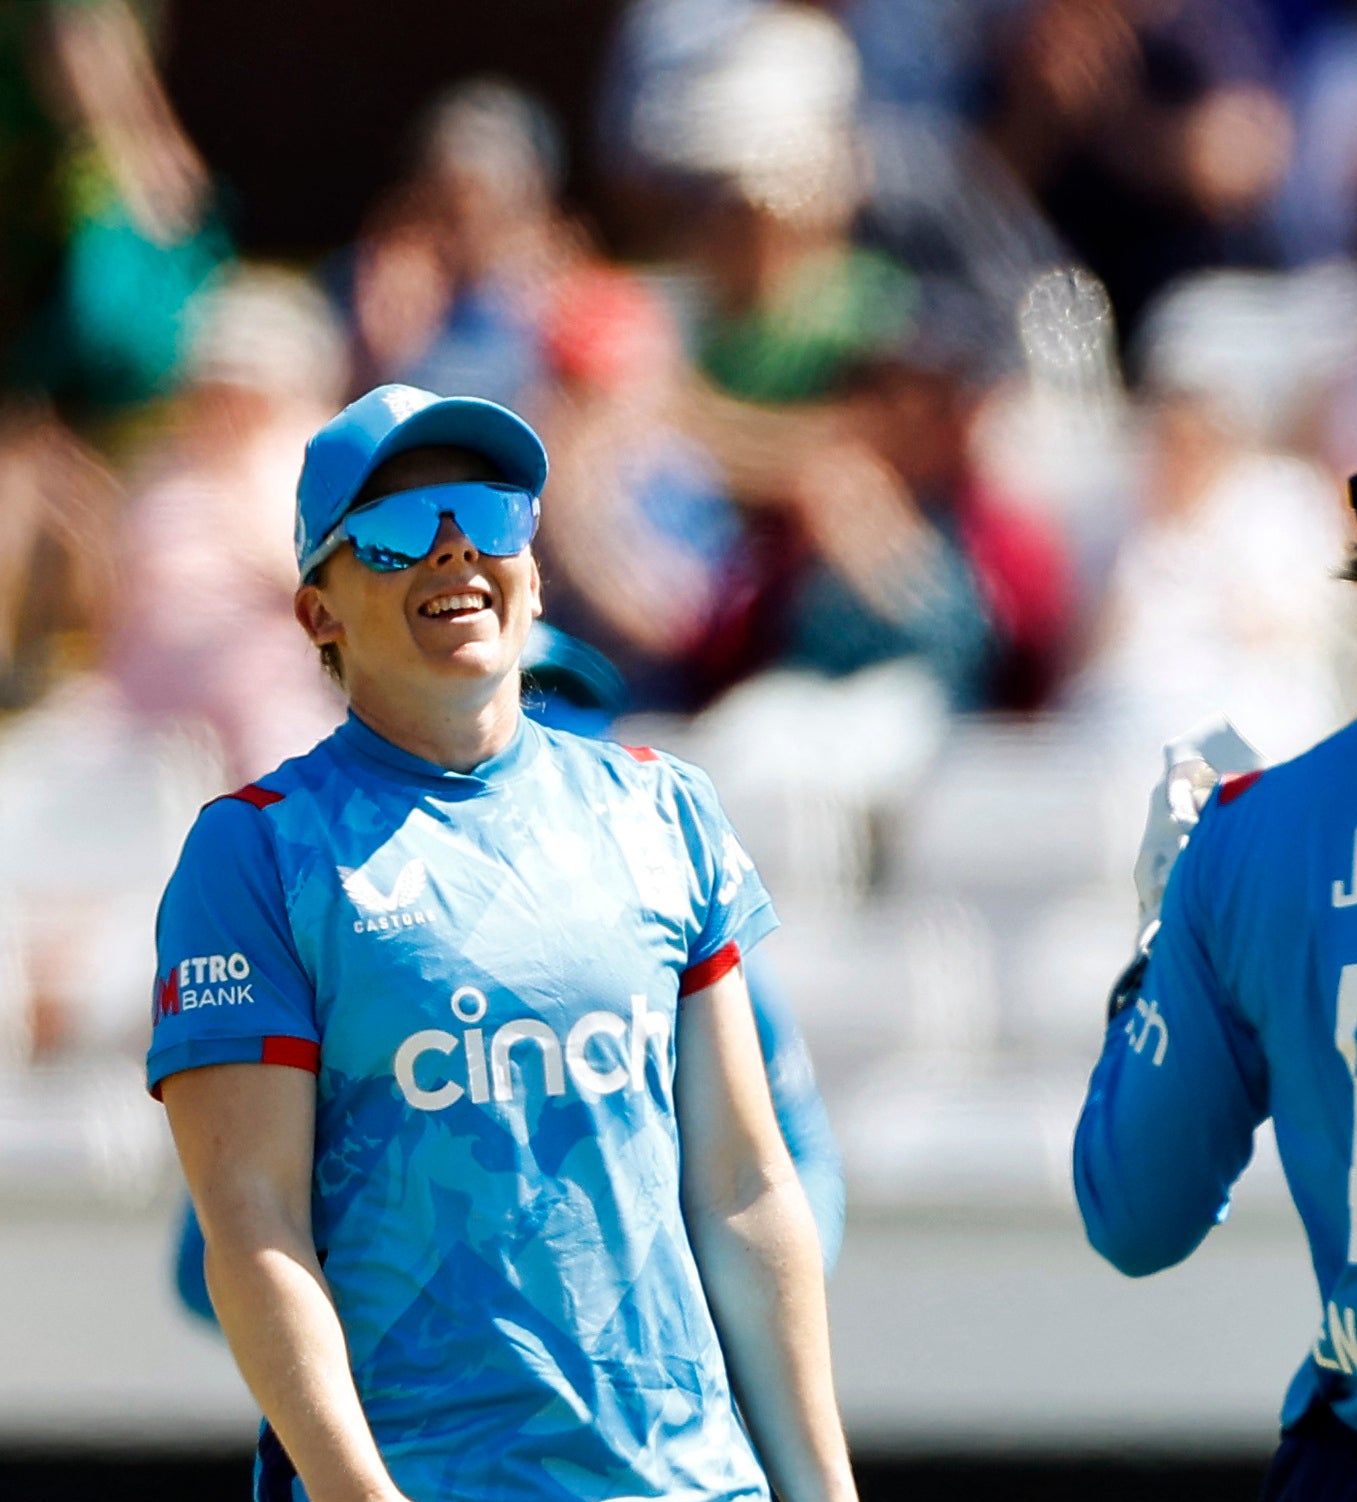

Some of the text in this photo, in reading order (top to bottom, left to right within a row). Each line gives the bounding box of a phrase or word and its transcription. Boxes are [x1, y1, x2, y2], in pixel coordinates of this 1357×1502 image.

[353, 909, 437, 934] CASTORE
[152, 952, 250, 1027] METRO
[182, 983, 255, 1011] BANK
[394, 985, 671, 1112] cinch
